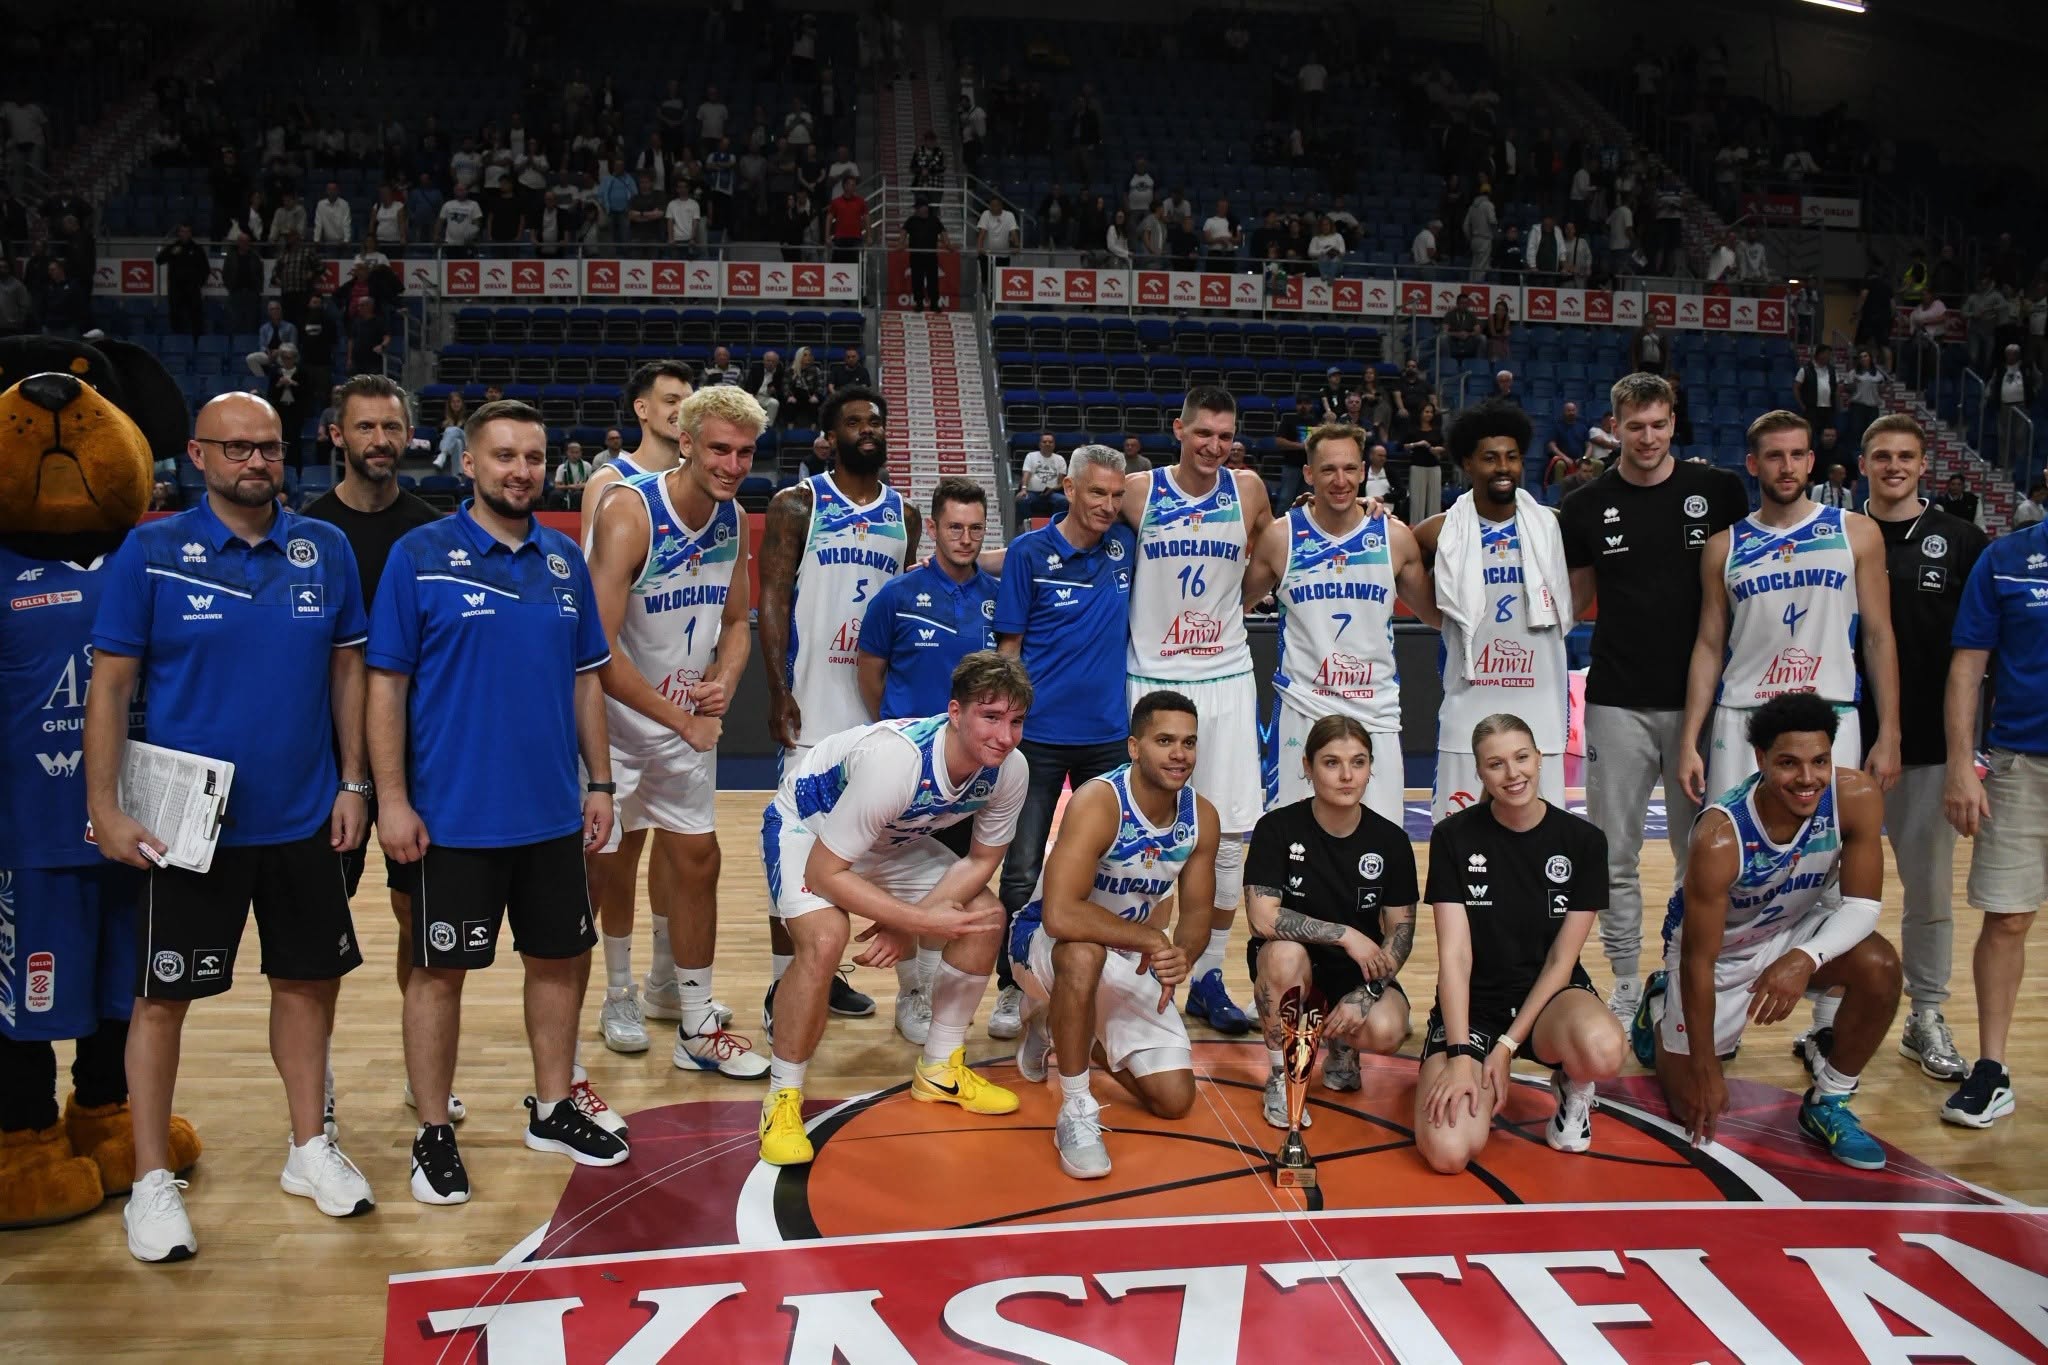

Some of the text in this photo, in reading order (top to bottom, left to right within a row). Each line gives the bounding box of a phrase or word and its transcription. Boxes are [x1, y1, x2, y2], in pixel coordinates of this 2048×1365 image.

[1143, 539, 1240, 562] WŁOCŁAWEK
[450, 559, 472, 567] errea
[852, 578, 869, 603] 5
[1178, 563, 1206, 600] 16
[1288, 582, 1388, 605] WŁOCŁAWEK
[1732, 568, 1848, 603] WŁOCŁAWEK
[14, 596, 46, 608] ORLEN
[1495, 594, 1518, 623] 8
[1542, 589, 1550, 608] ORLEN
[1162, 614, 1222, 645] Anwil
[1332, 613, 1352, 643] 7
[1782, 602, 1808, 638] 4
[684, 616, 697, 656] 1
[828, 656, 856, 665] GRUPA
[1194, 646, 1222, 656] ORLEN
[1474, 644, 1534, 674] Anwil
[1312, 657, 1373, 686] Anwil
[1758, 654, 1822, 686] Anwil
[1343, 690, 1373, 698] ORLEN
[1503, 678, 1533, 687] ORLEN
[1752, 906, 1788, 928] 2
[197, 968, 220, 976] ORLEN
